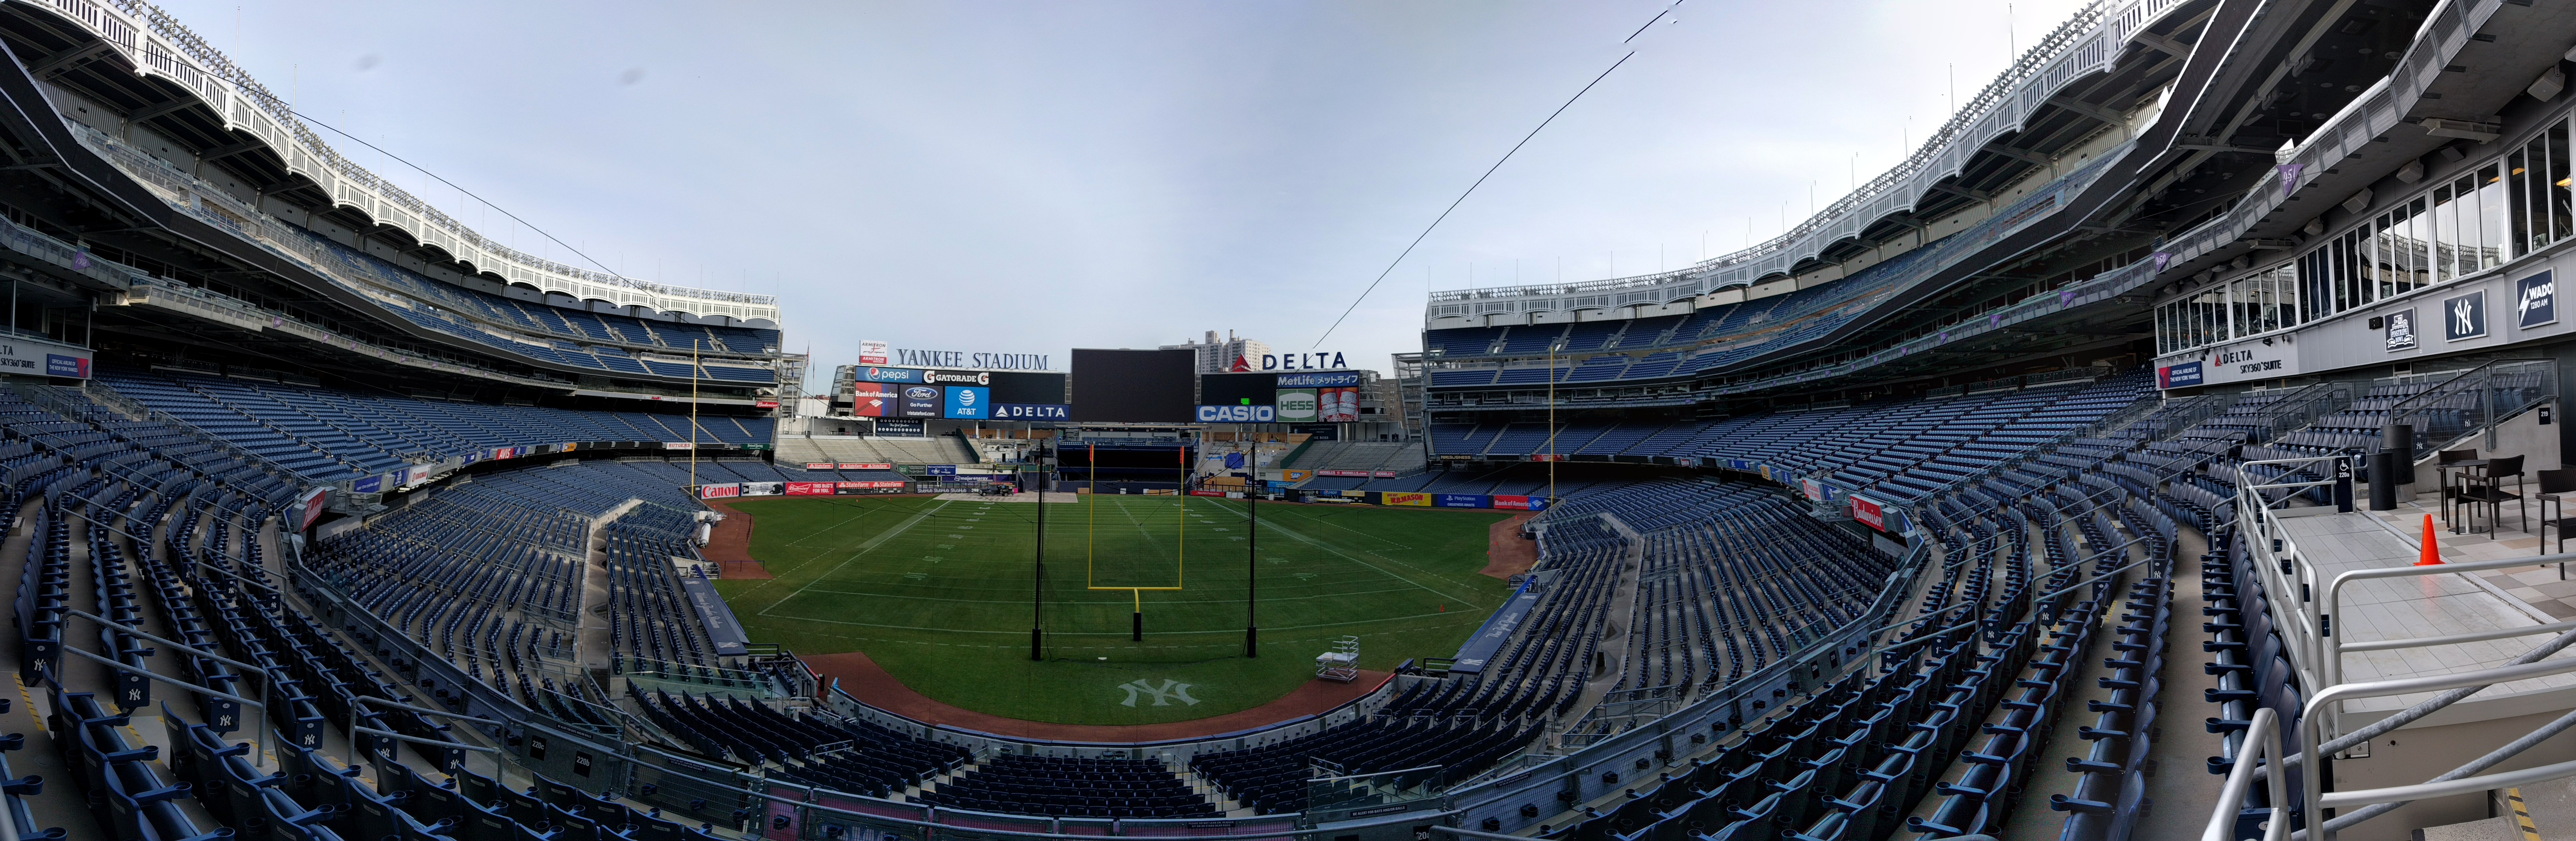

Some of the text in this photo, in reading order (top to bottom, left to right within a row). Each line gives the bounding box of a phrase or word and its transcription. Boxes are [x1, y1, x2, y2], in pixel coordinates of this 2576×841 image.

[75, 257, 87, 267] 1958
[2156, 254, 2166, 265] 950
[2529, 282, 2552, 300] WADO
[2062, 293, 2070, 302] 949
[2530, 298, 2548, 310] 1280 AM
[2454, 299, 2473, 335] NY
[2392, 328, 2408, 338] PINSTRIPE
[896, 349, 1048, 370] YANKEE STADIUM
[1263, 352, 1347, 370] DELTA
[2223, 350, 2253, 364] DELTA
[21, 360, 35, 369] SUITE
[2263, 360, 2281, 371] SUITE
[882, 370, 909, 381] pepsi
[924, 370, 989, 385] G GATORADE G
[1278, 375, 1358, 386] MetLife メットライフ
[911, 389, 931, 399] Ford
[1280, 400, 1314, 410] HESS
[1013, 407, 1065, 418] DELTA
[1199, 407, 1273, 421] CASIO
[498, 448, 511, 459] AVIS
[703, 486, 739, 497] Canon
[1850, 498, 1882, 527] Budweiser
[532, 740, 544, 750] 220c
[576, 756, 590, 766] 220b
